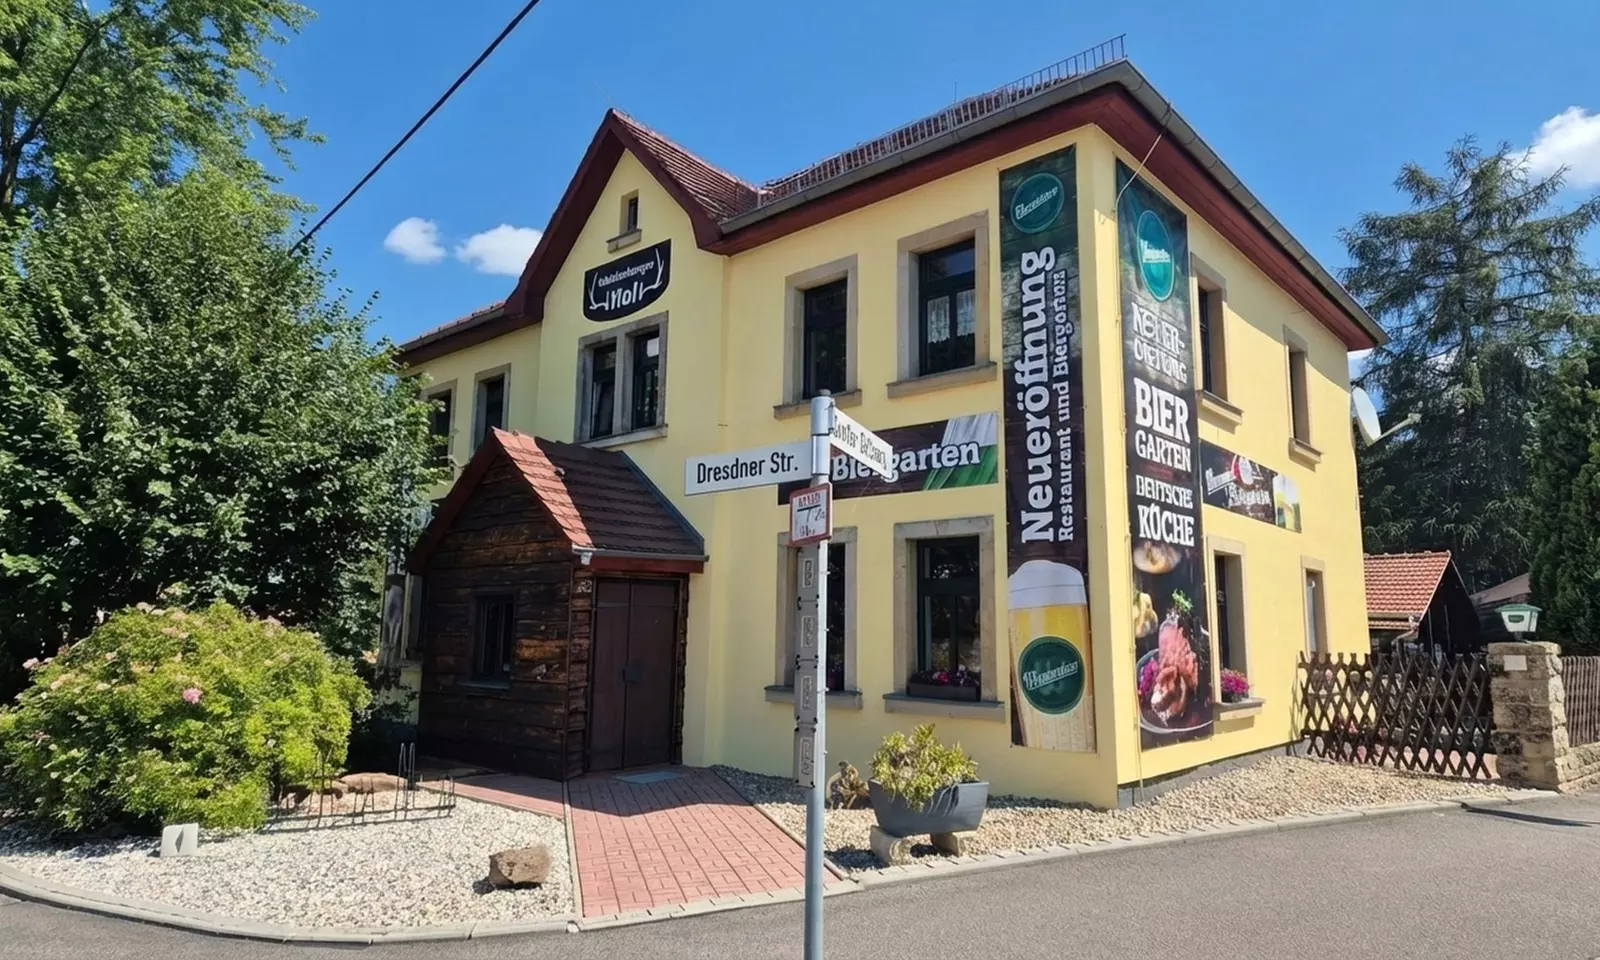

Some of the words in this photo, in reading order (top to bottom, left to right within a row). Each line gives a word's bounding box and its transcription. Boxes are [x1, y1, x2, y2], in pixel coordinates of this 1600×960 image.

[1014, 246, 1056, 543] Neueröffnung
[1053, 381, 1070, 420] und
[1133, 377, 1190, 444] BIER
[697, 457, 766, 484] Dresdner
[770, 451, 799, 474] Str.
[831, 441, 981, 484] Biegarten
[1135, 430, 1192, 473] GARTEN
[1058, 427, 1074, 541] Restaurant
